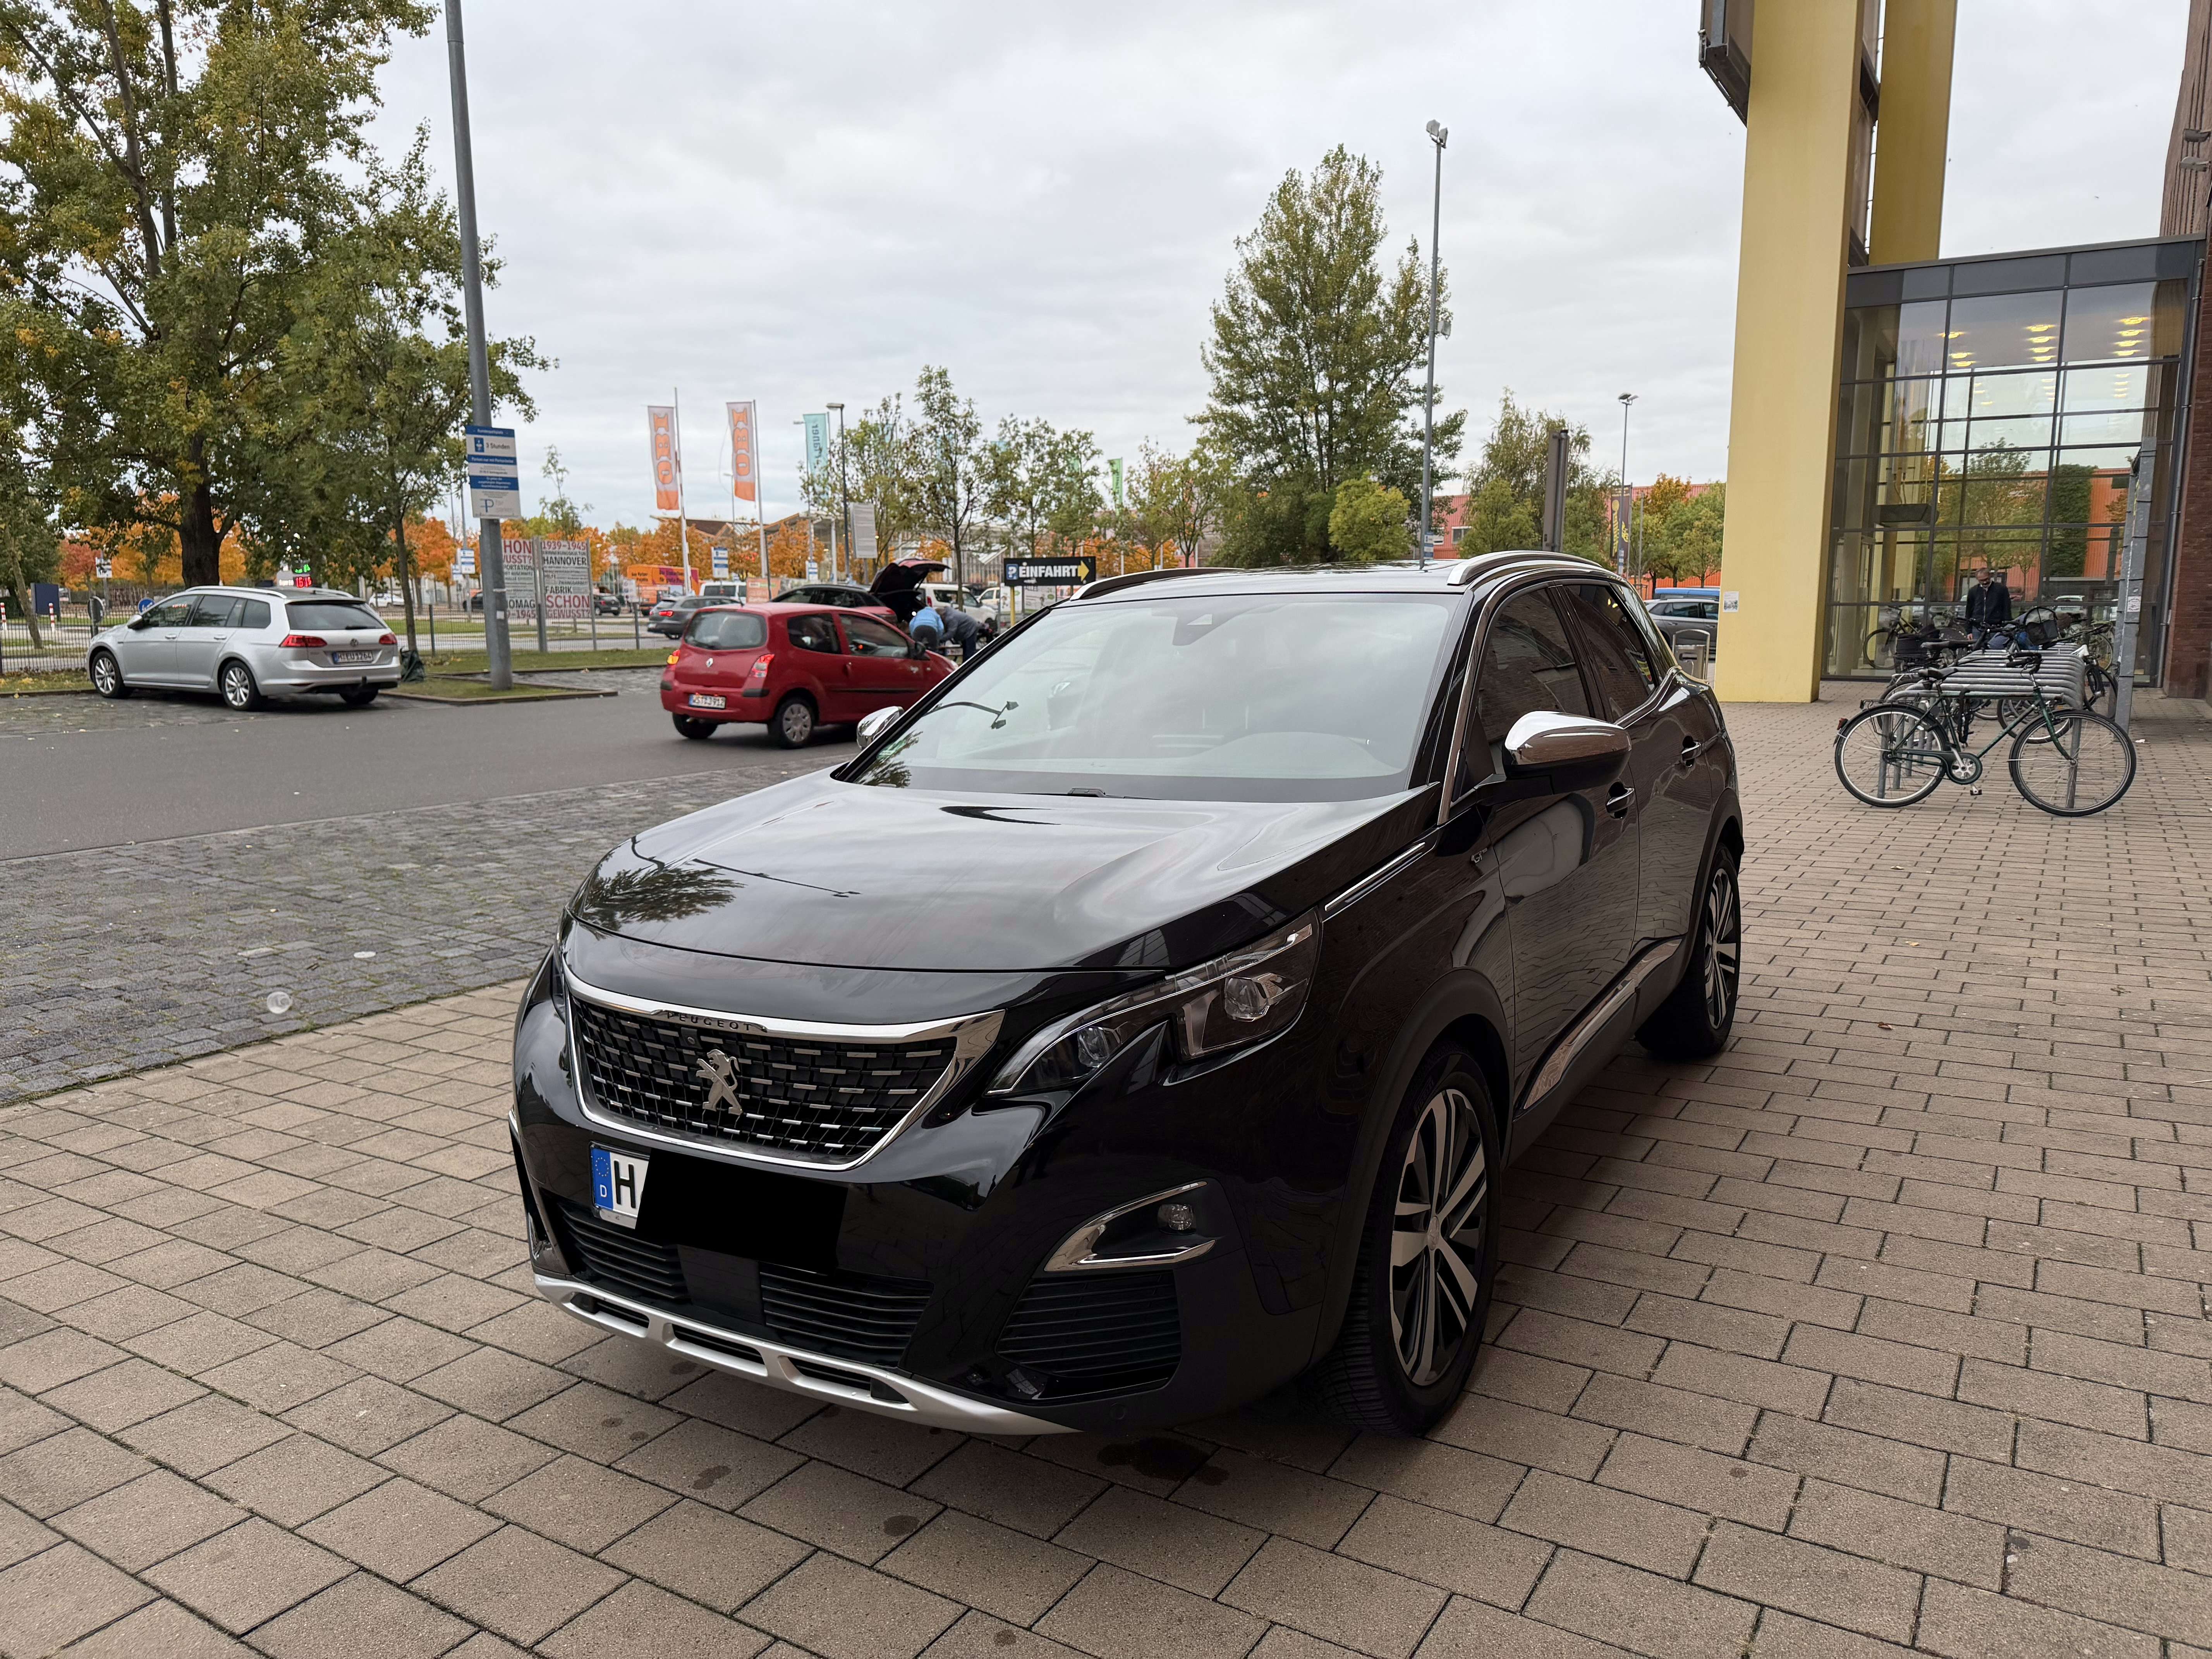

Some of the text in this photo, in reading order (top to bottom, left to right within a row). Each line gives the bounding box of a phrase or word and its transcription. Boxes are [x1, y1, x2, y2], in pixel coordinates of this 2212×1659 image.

[503, 540, 532, 553] HON
[504, 554, 532, 564] USST?
[543, 556, 587, 565] HANNOVER
[1019, 565, 1078, 578] EINFAHRT
[545, 586, 572, 594] FABRIK
[508, 599, 536, 609] OMAG
[546, 594, 590, 608] SCHON
[547, 608, 591, 619] GEWUSST?
[667, 1012, 752, 1031] PEUGEOT
[600, 1184, 607, 1197] D
[613, 1159, 636, 1209] H
